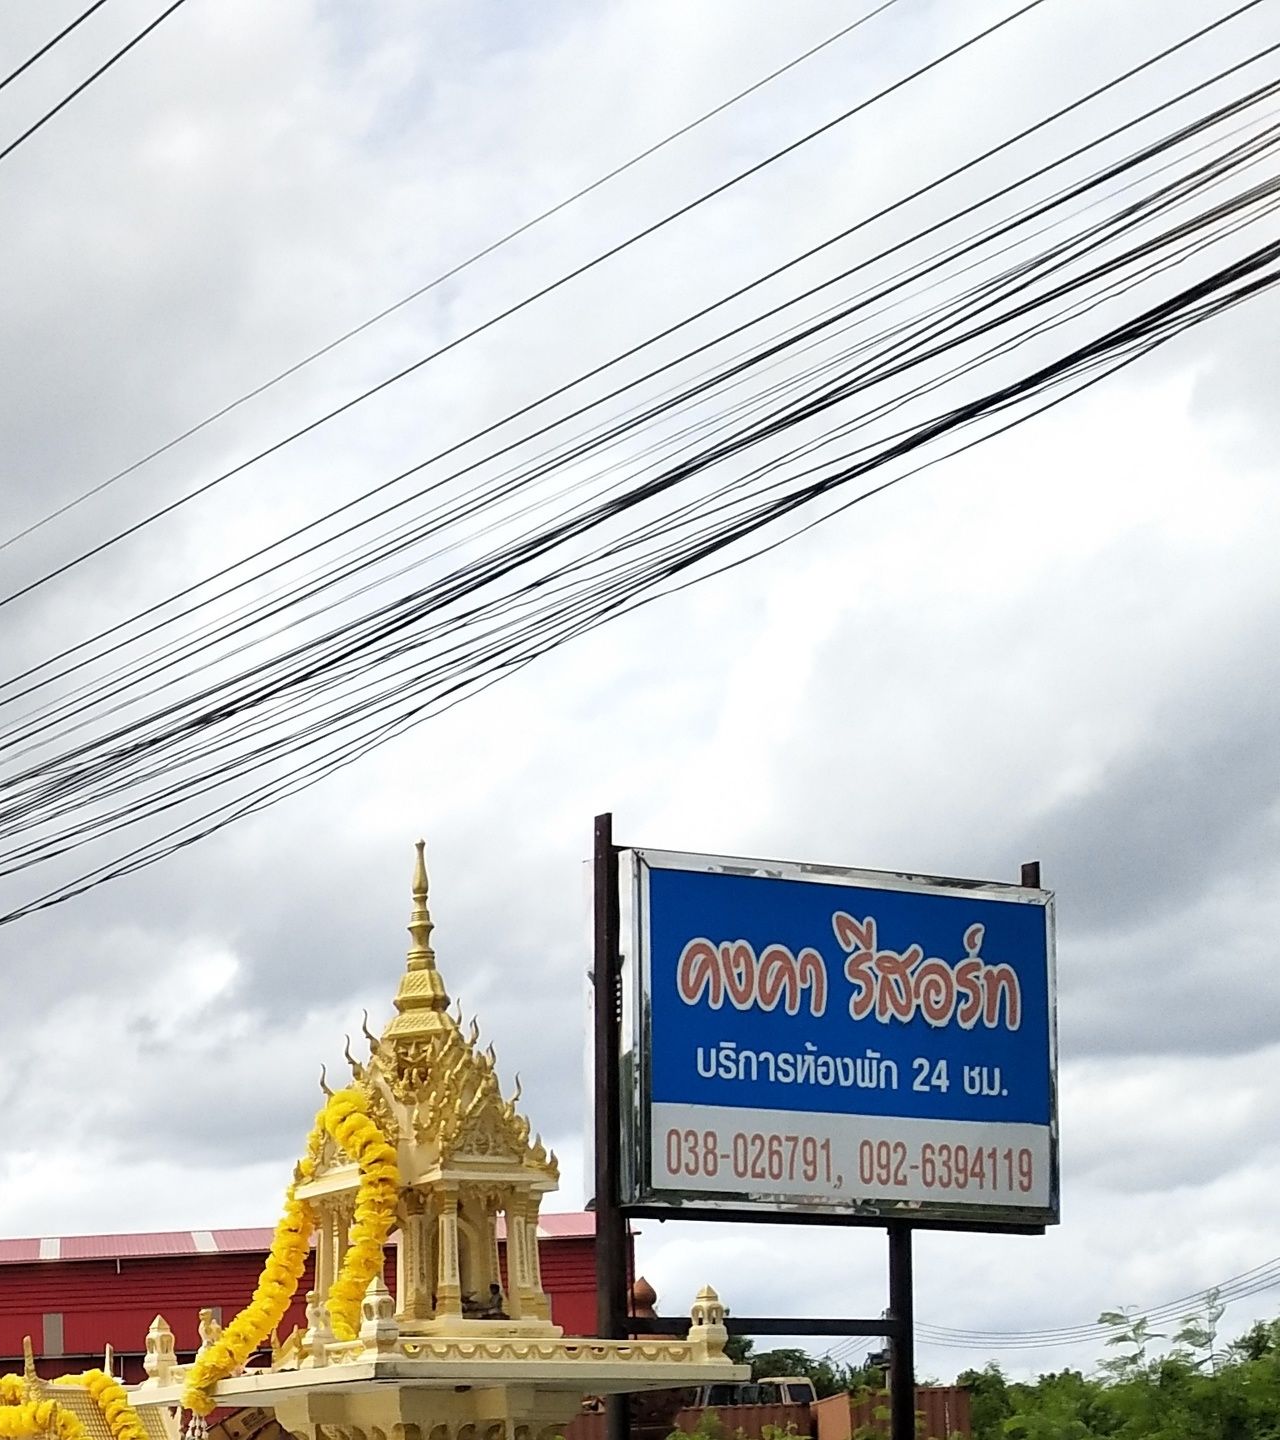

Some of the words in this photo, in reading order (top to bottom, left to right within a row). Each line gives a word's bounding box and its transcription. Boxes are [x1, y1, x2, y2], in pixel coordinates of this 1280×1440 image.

[677, 938, 827, 1018] คงคา
[832, 911, 1021, 1031] รีสอร์ท
[697, 1042, 899, 1090] บริการห้องพัก
[912, 1058, 949, 1093] 24
[963, 1064, 1009, 1096] ชม.
[666, 1128, 843, 1189] 038-026791,
[859, 1139, 1033, 1192] 092-6394119
